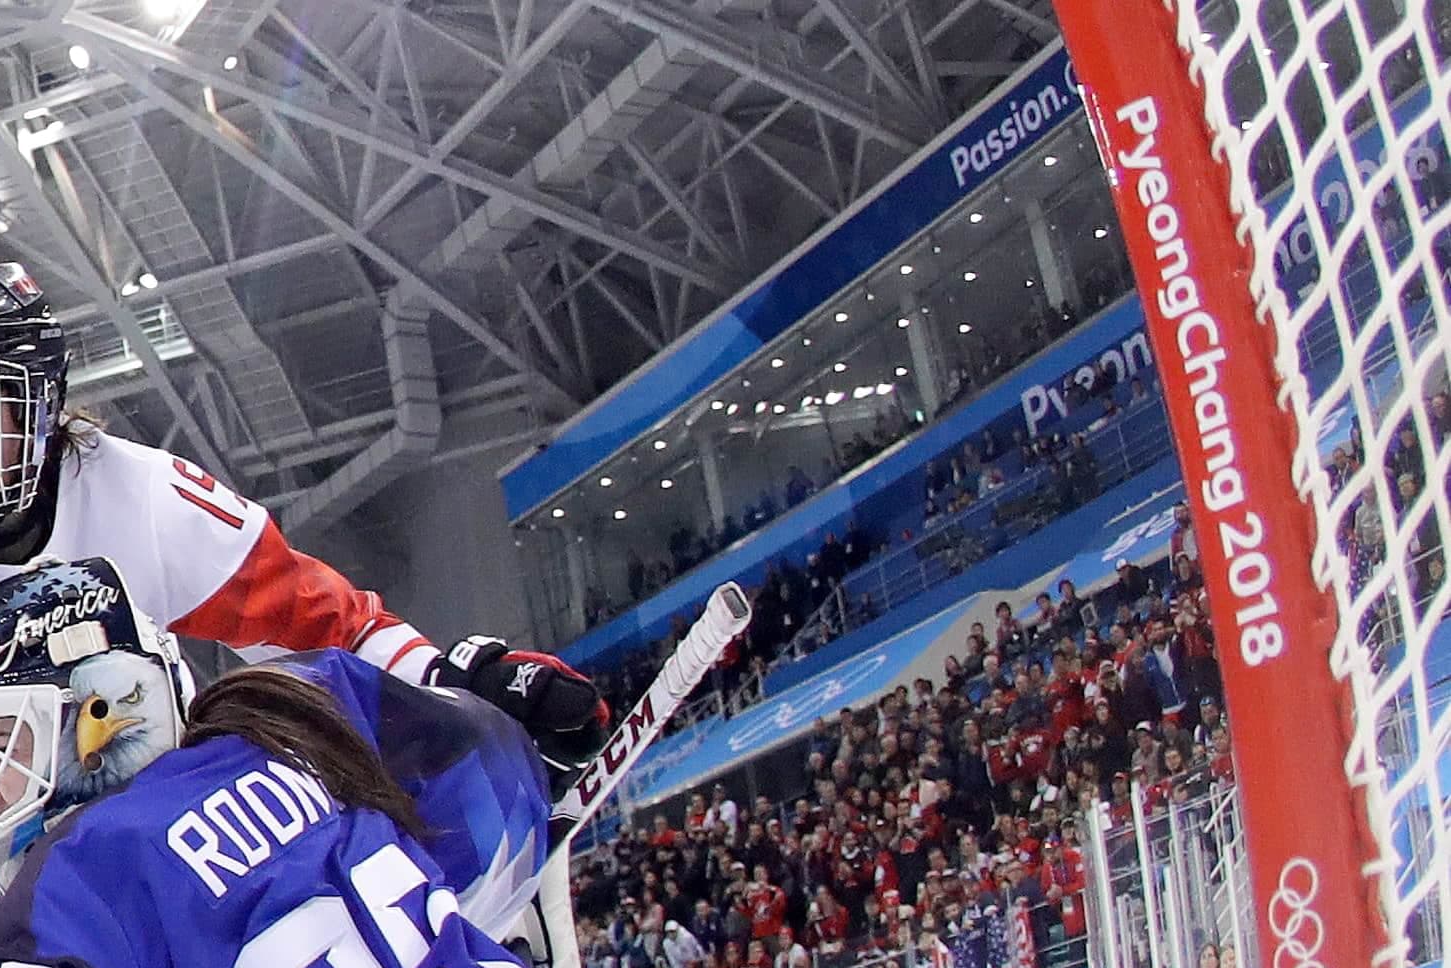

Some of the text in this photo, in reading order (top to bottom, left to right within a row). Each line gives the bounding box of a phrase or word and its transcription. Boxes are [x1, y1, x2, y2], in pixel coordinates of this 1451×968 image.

[950, 84, 1069, 189] Passion.
[1116, 96, 1284, 667] PyeongChang 2018
[575, 697, 657, 807] CCM
